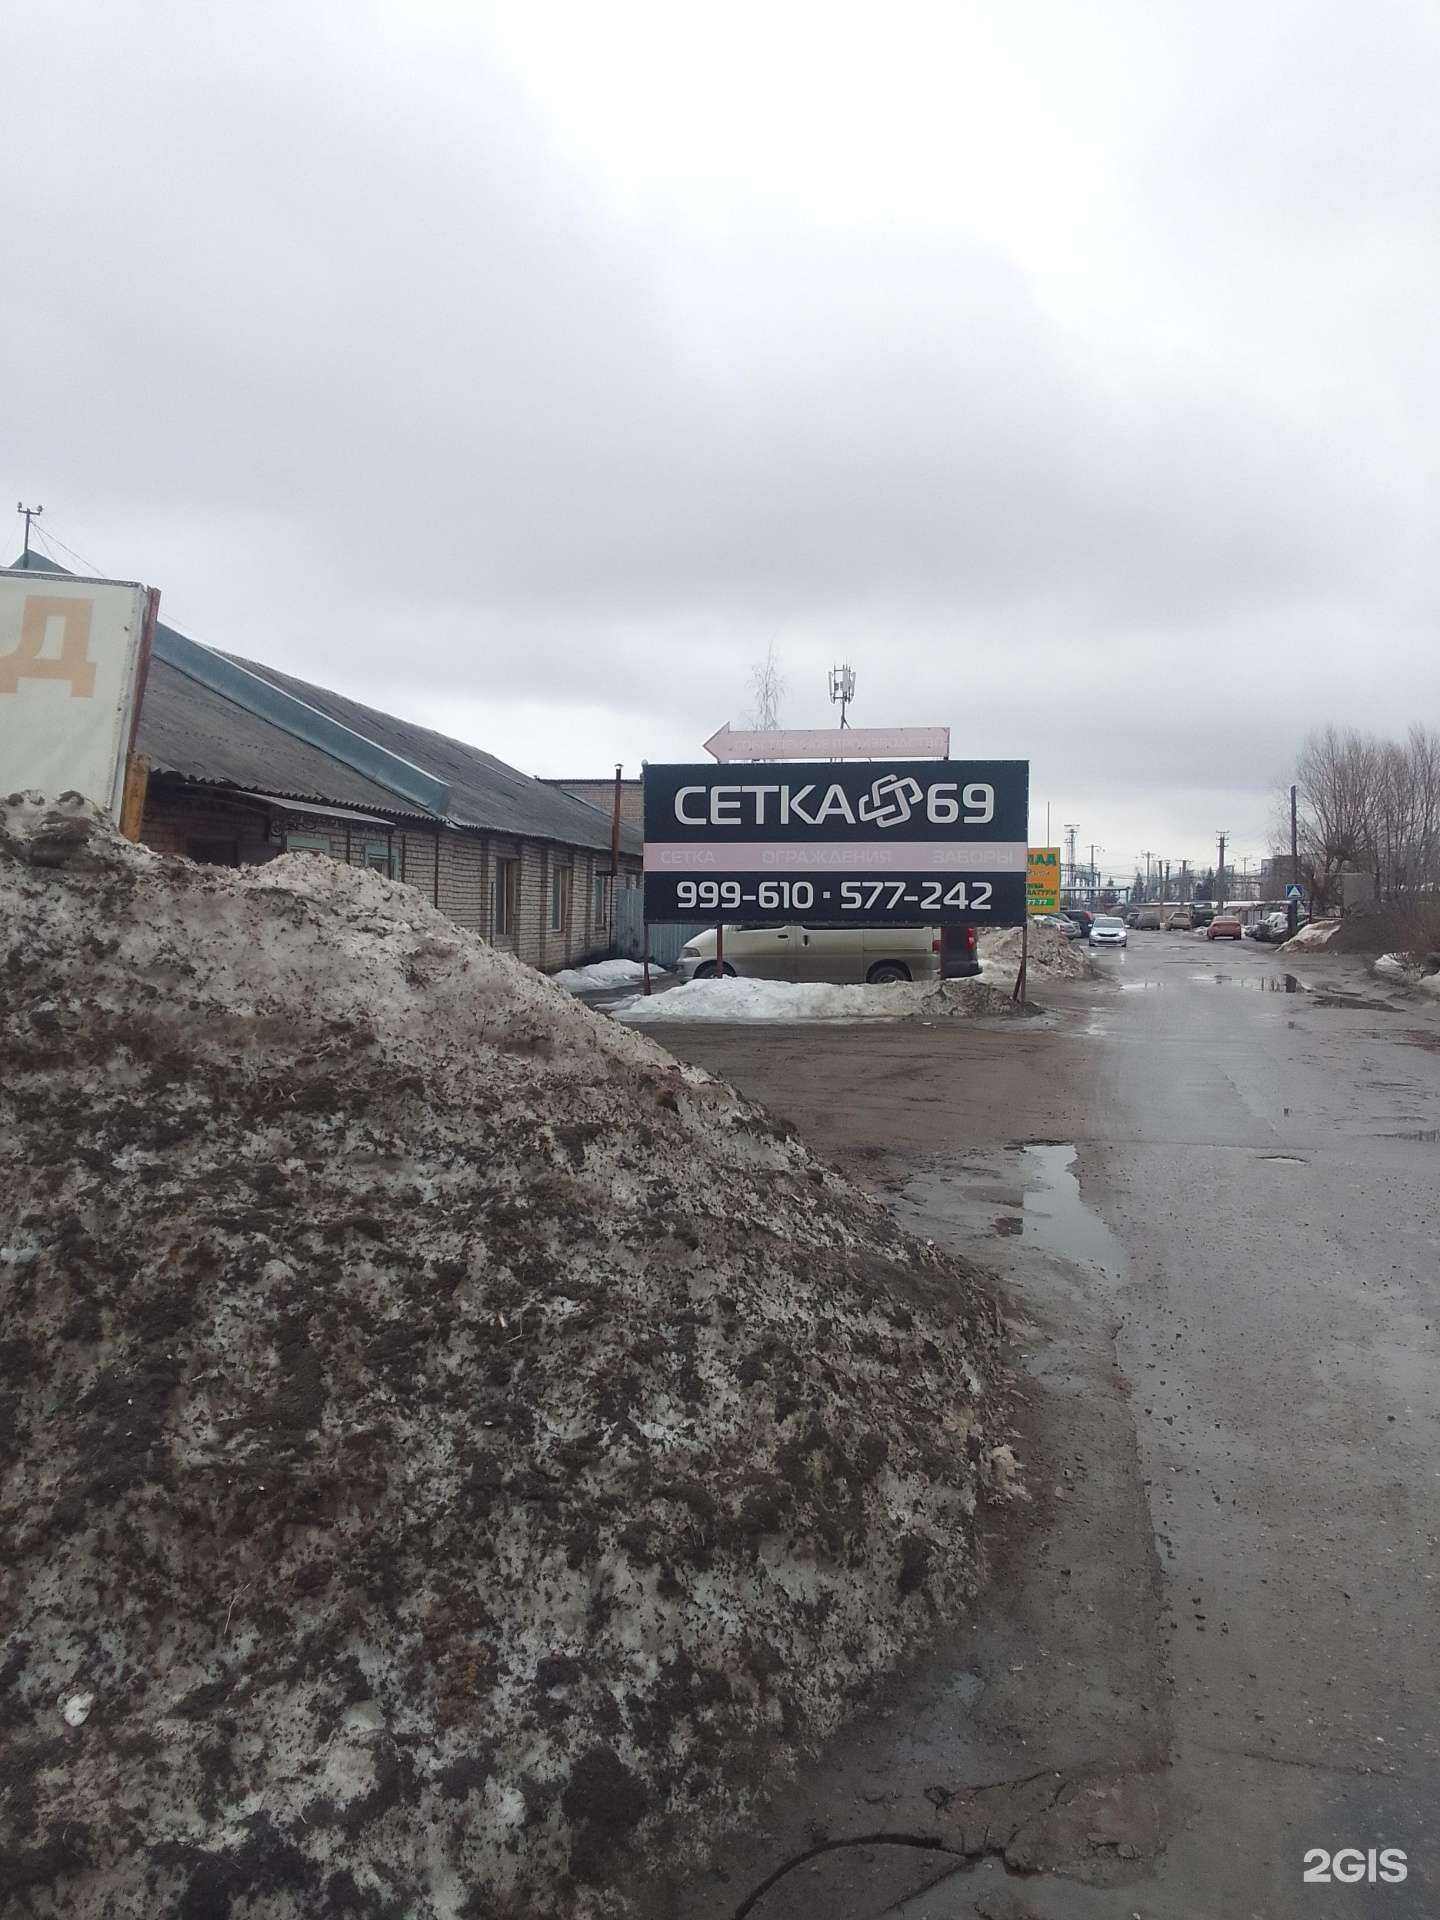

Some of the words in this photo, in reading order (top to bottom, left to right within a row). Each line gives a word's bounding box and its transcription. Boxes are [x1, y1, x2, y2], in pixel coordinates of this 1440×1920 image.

[674, 784, 856, 825] СЕТКА
[926, 783, 995, 824] 69
[660, 849, 715, 864] СЕТКА
[761, 849, 891, 864] ОГРАЖДЕНИЯ
[933, 849, 1013, 864] ЗАБОРЫ
[676, 881, 814, 909] 999-610
[841, 881, 992, 910] 577-242
